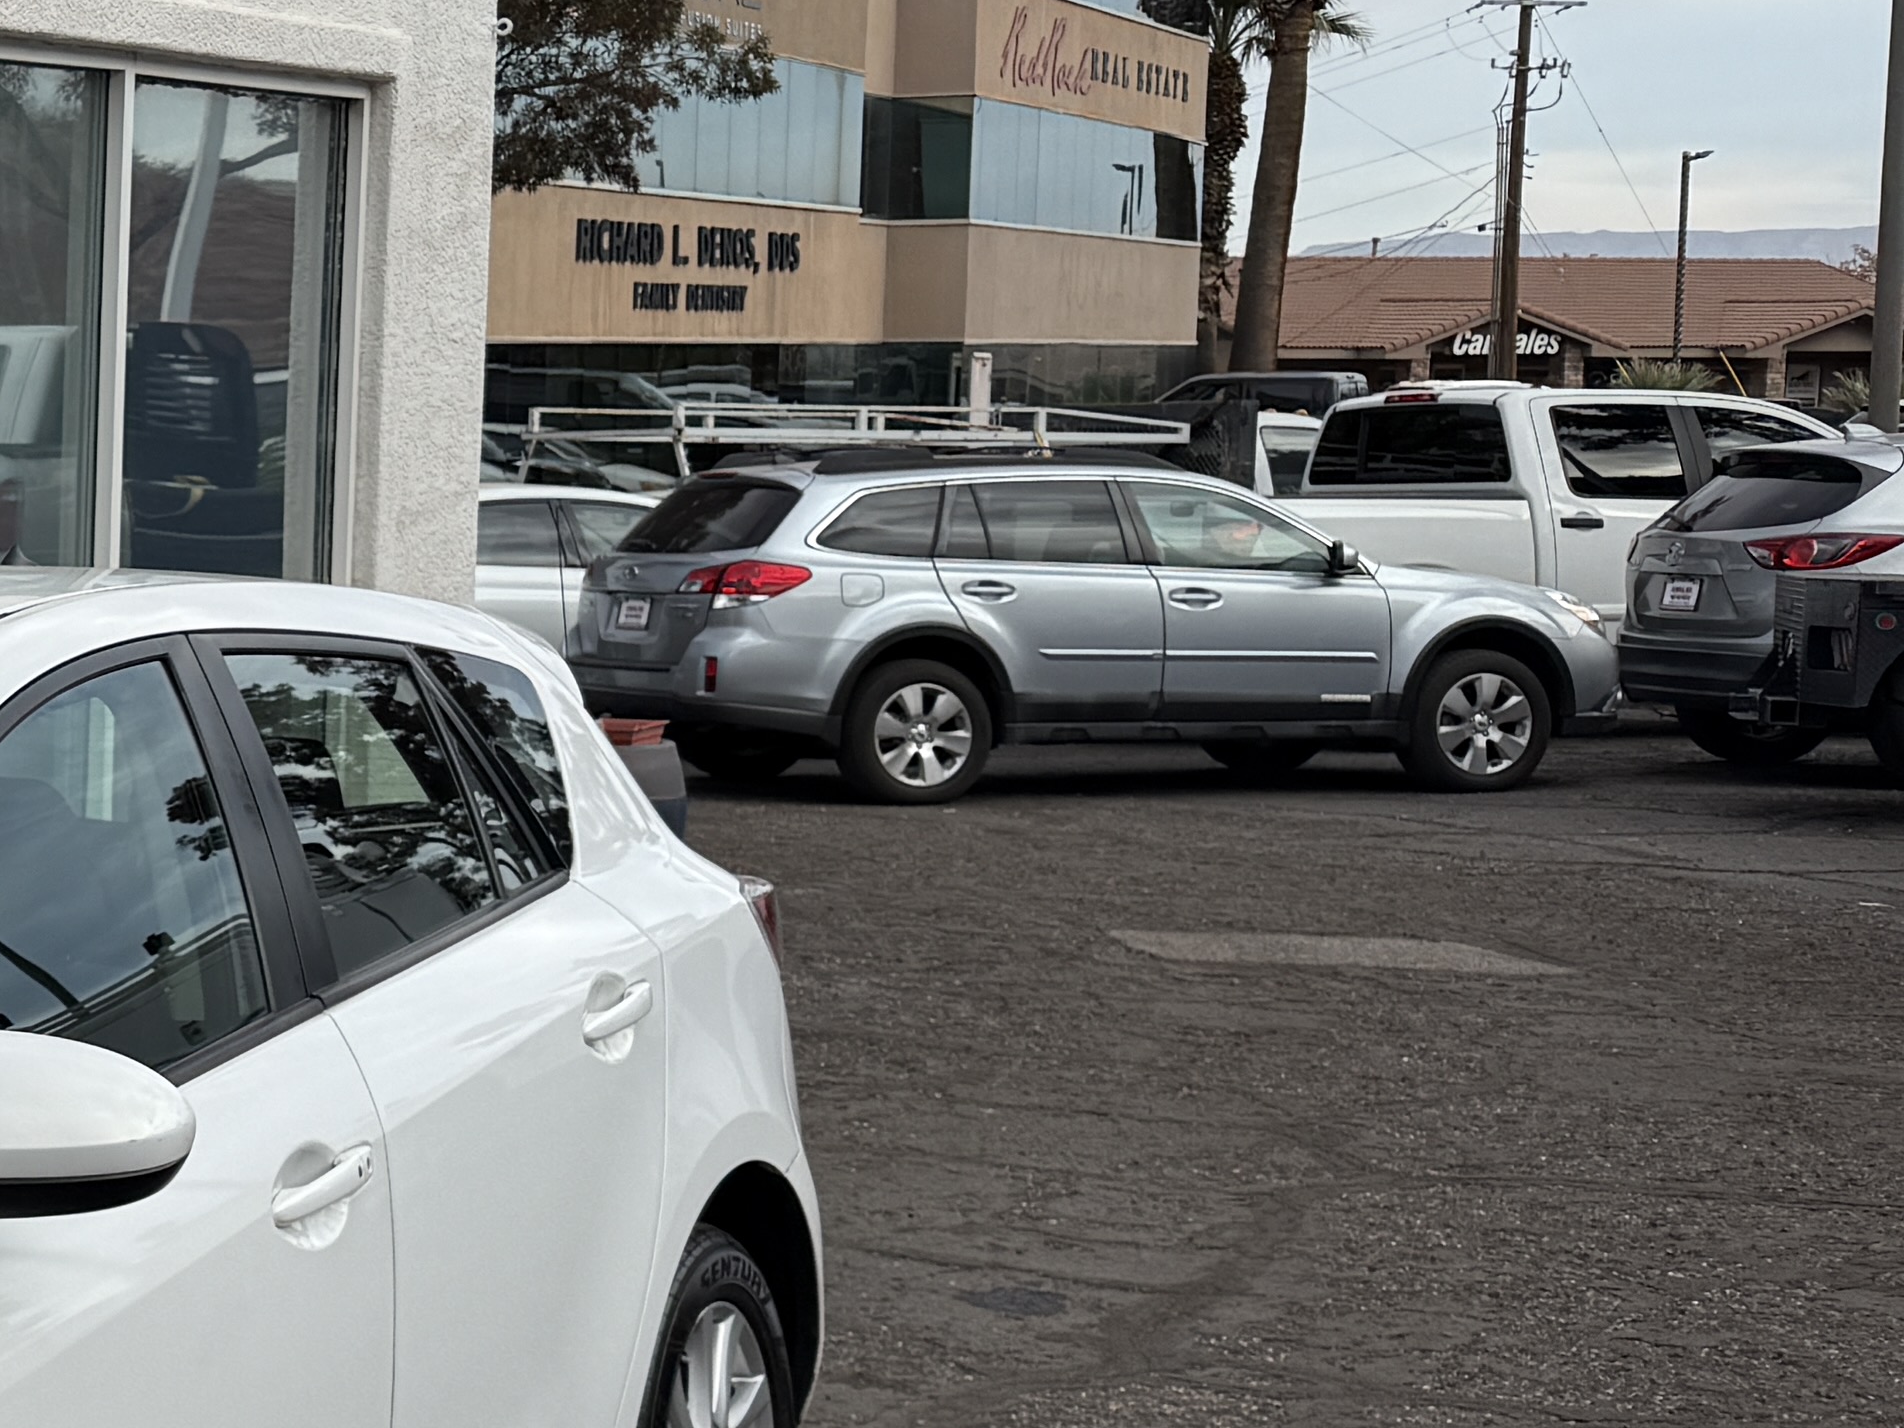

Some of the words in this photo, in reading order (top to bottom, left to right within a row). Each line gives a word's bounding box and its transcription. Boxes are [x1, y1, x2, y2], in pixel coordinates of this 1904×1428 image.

[1090, 47, 1130, 89] REAL
[1136, 60, 1190, 103] ESTATE
[574, 218, 665, 265] RICHARD
[671, 224, 690, 267] L.
[767, 231, 801, 273] DDS
[632, 281, 681, 312] FAMILY
[685, 283, 749, 313] DENTISTRY
[1514, 328, 1562, 355] ales
